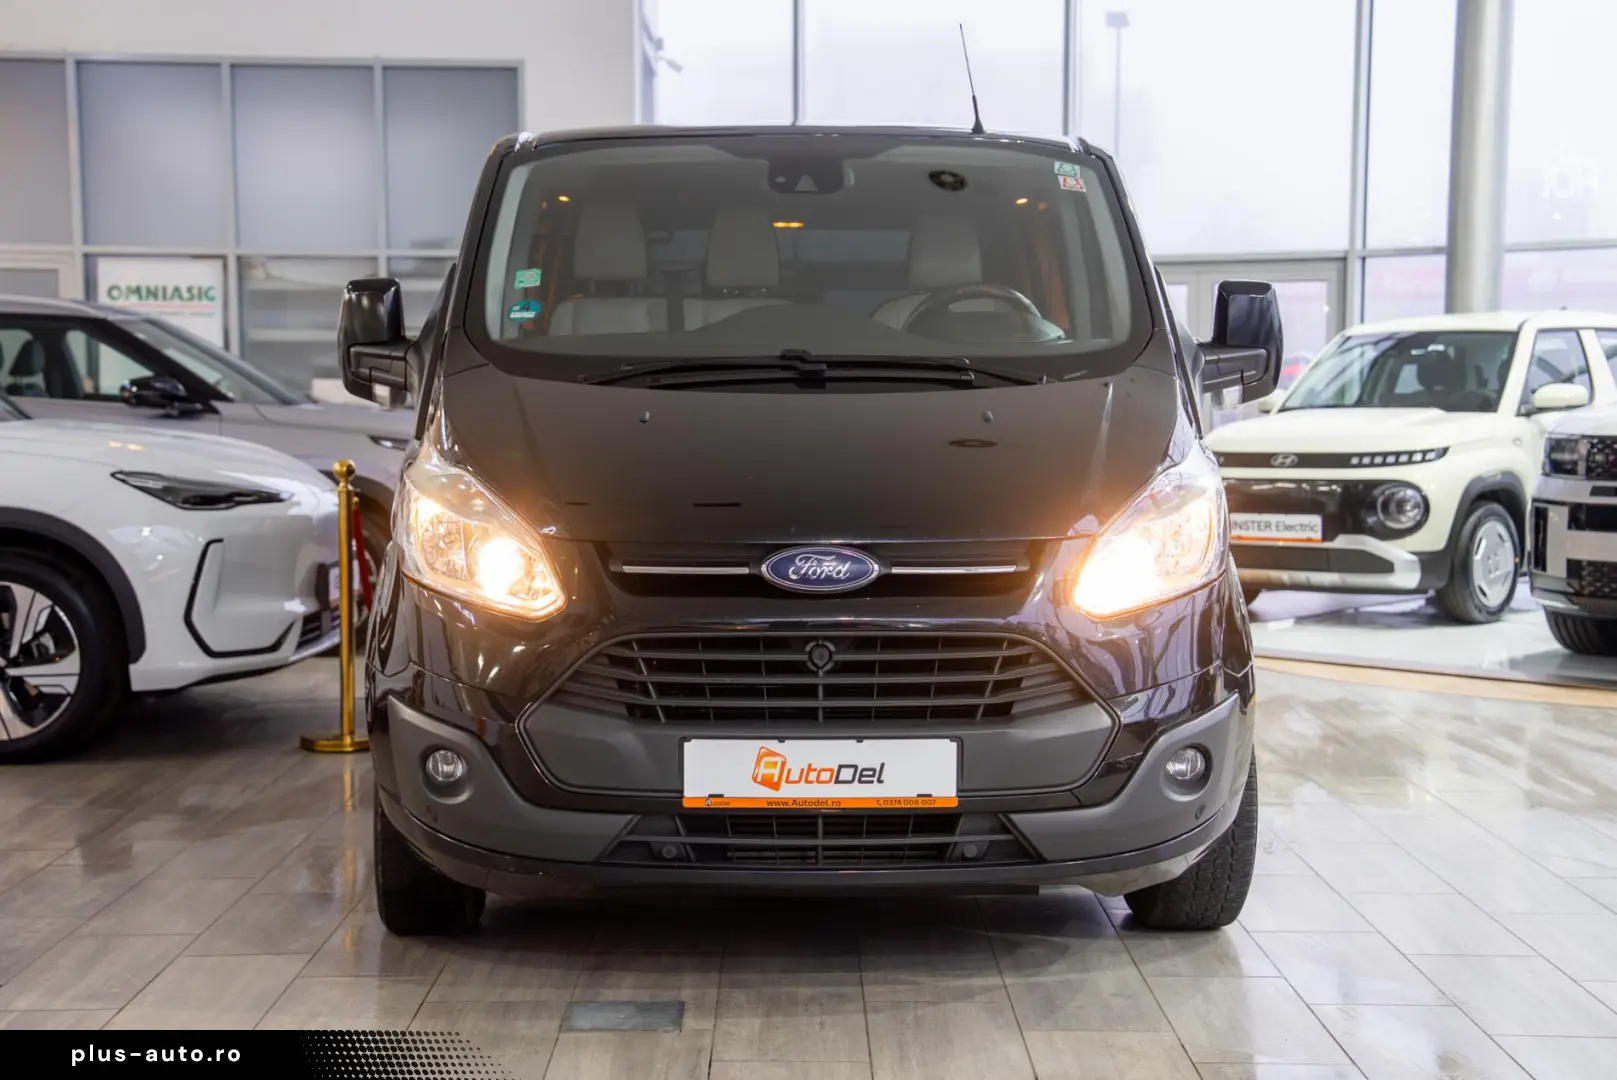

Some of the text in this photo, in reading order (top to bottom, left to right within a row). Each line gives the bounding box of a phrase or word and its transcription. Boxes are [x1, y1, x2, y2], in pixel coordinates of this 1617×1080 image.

[1275, 520, 1319, 533] Electric
[788, 553, 851, 580] Ford
[752, 746, 885, 792] AutoDel
[766, 799, 841, 807] www.Autodel.ro
